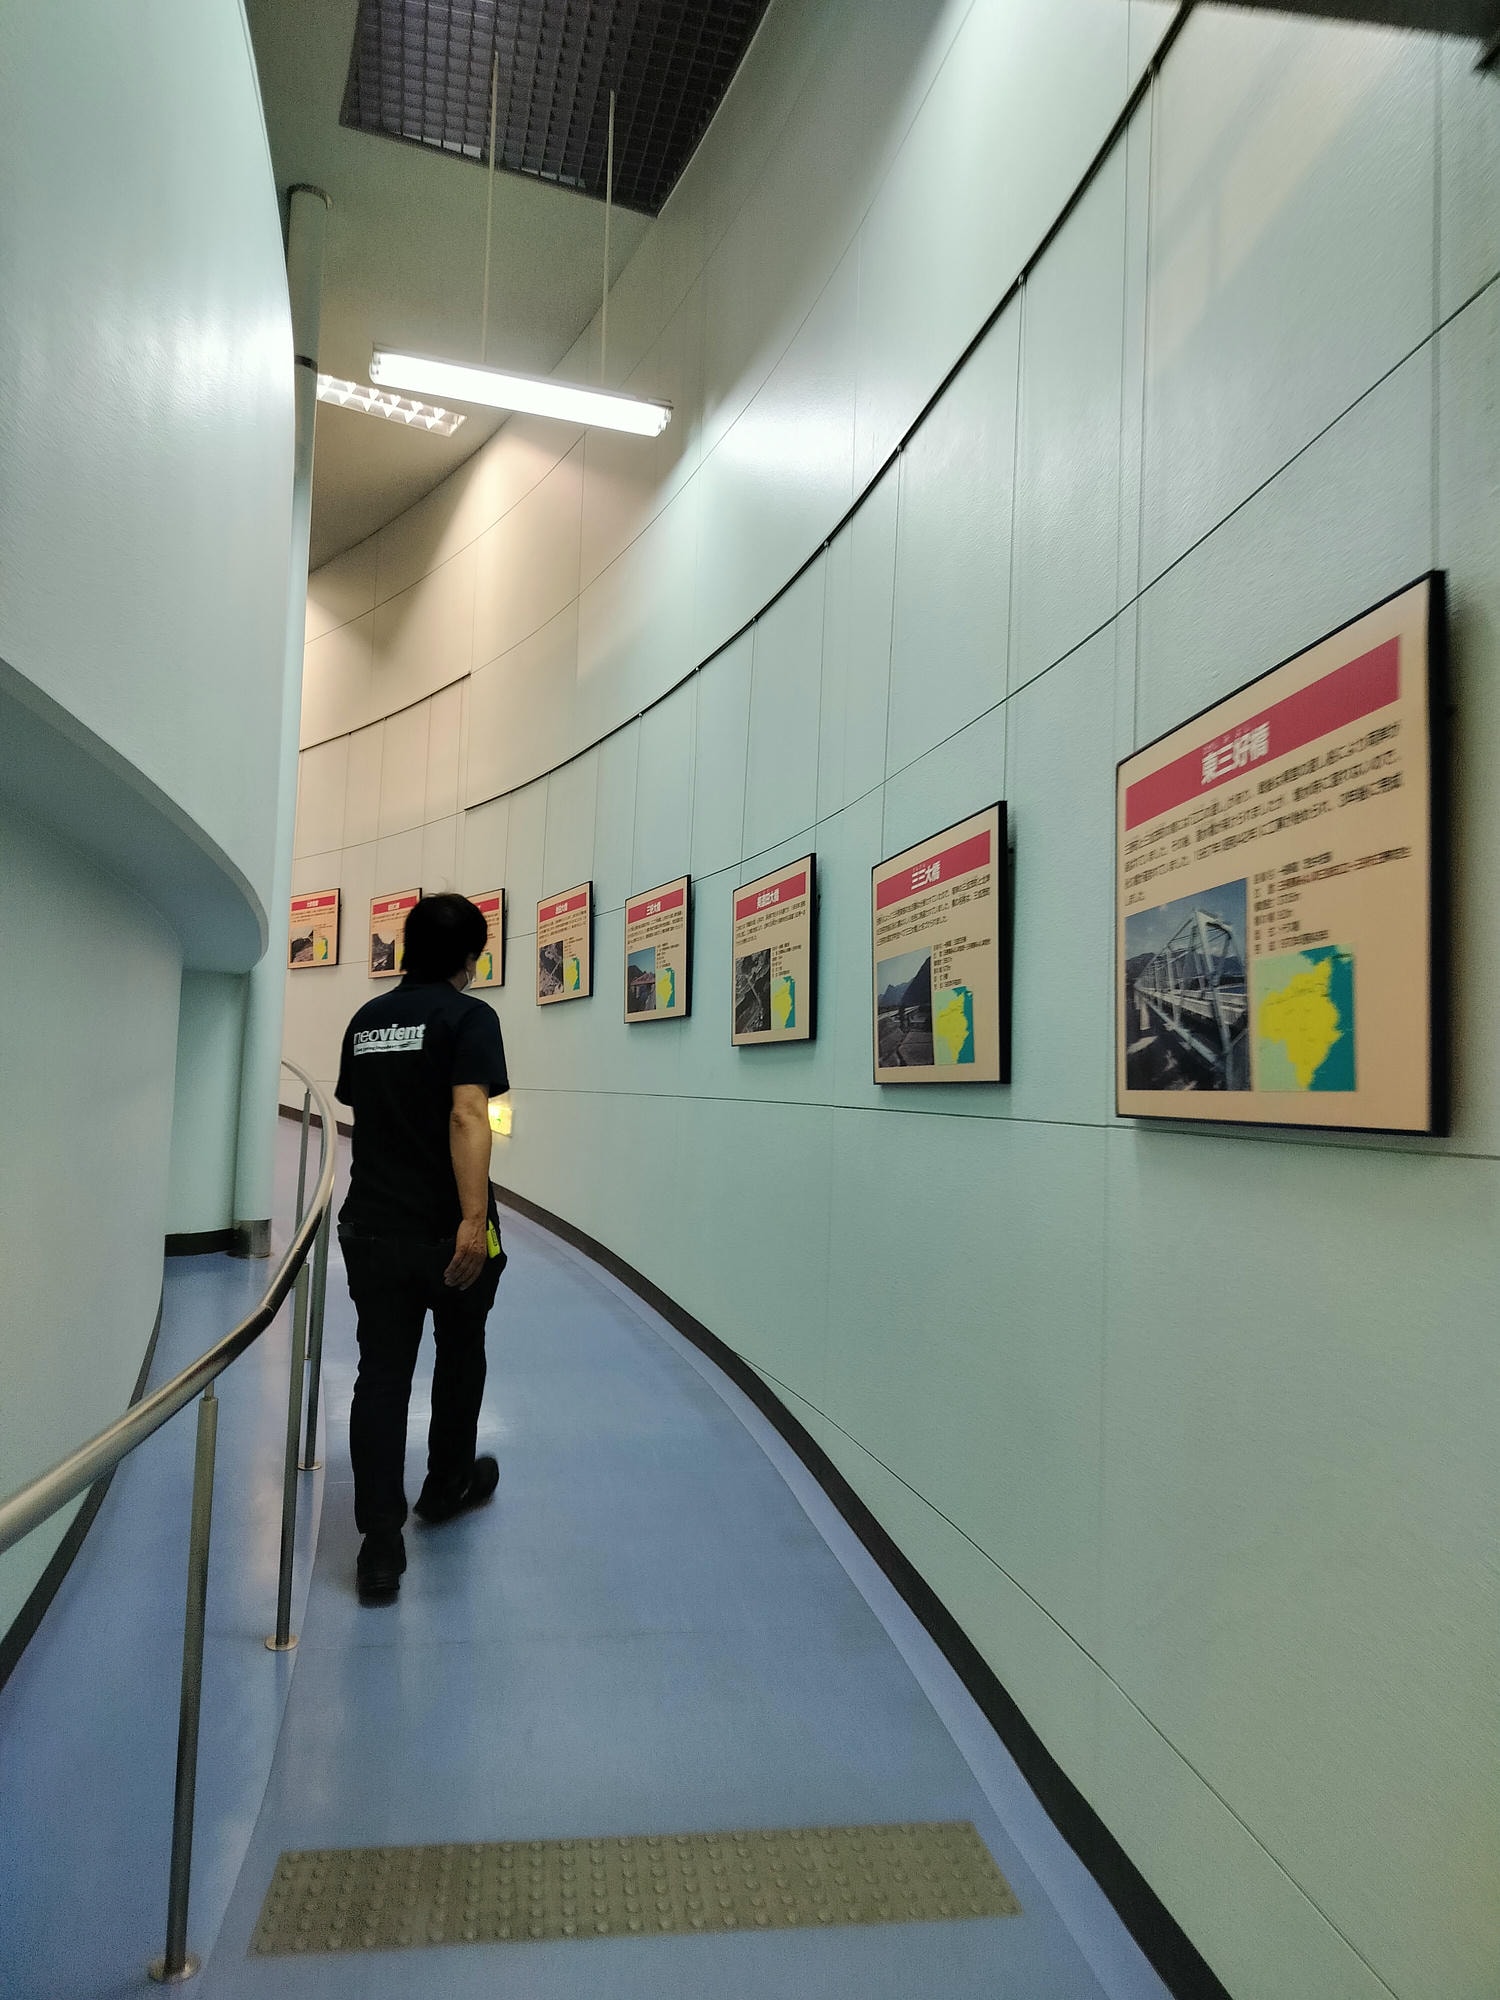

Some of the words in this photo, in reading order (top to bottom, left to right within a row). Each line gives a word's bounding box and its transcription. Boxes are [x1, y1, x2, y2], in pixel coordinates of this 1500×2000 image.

[1201, 721, 1270, 785] 東三好橋
[354, 1024, 426, 1045] neovient
